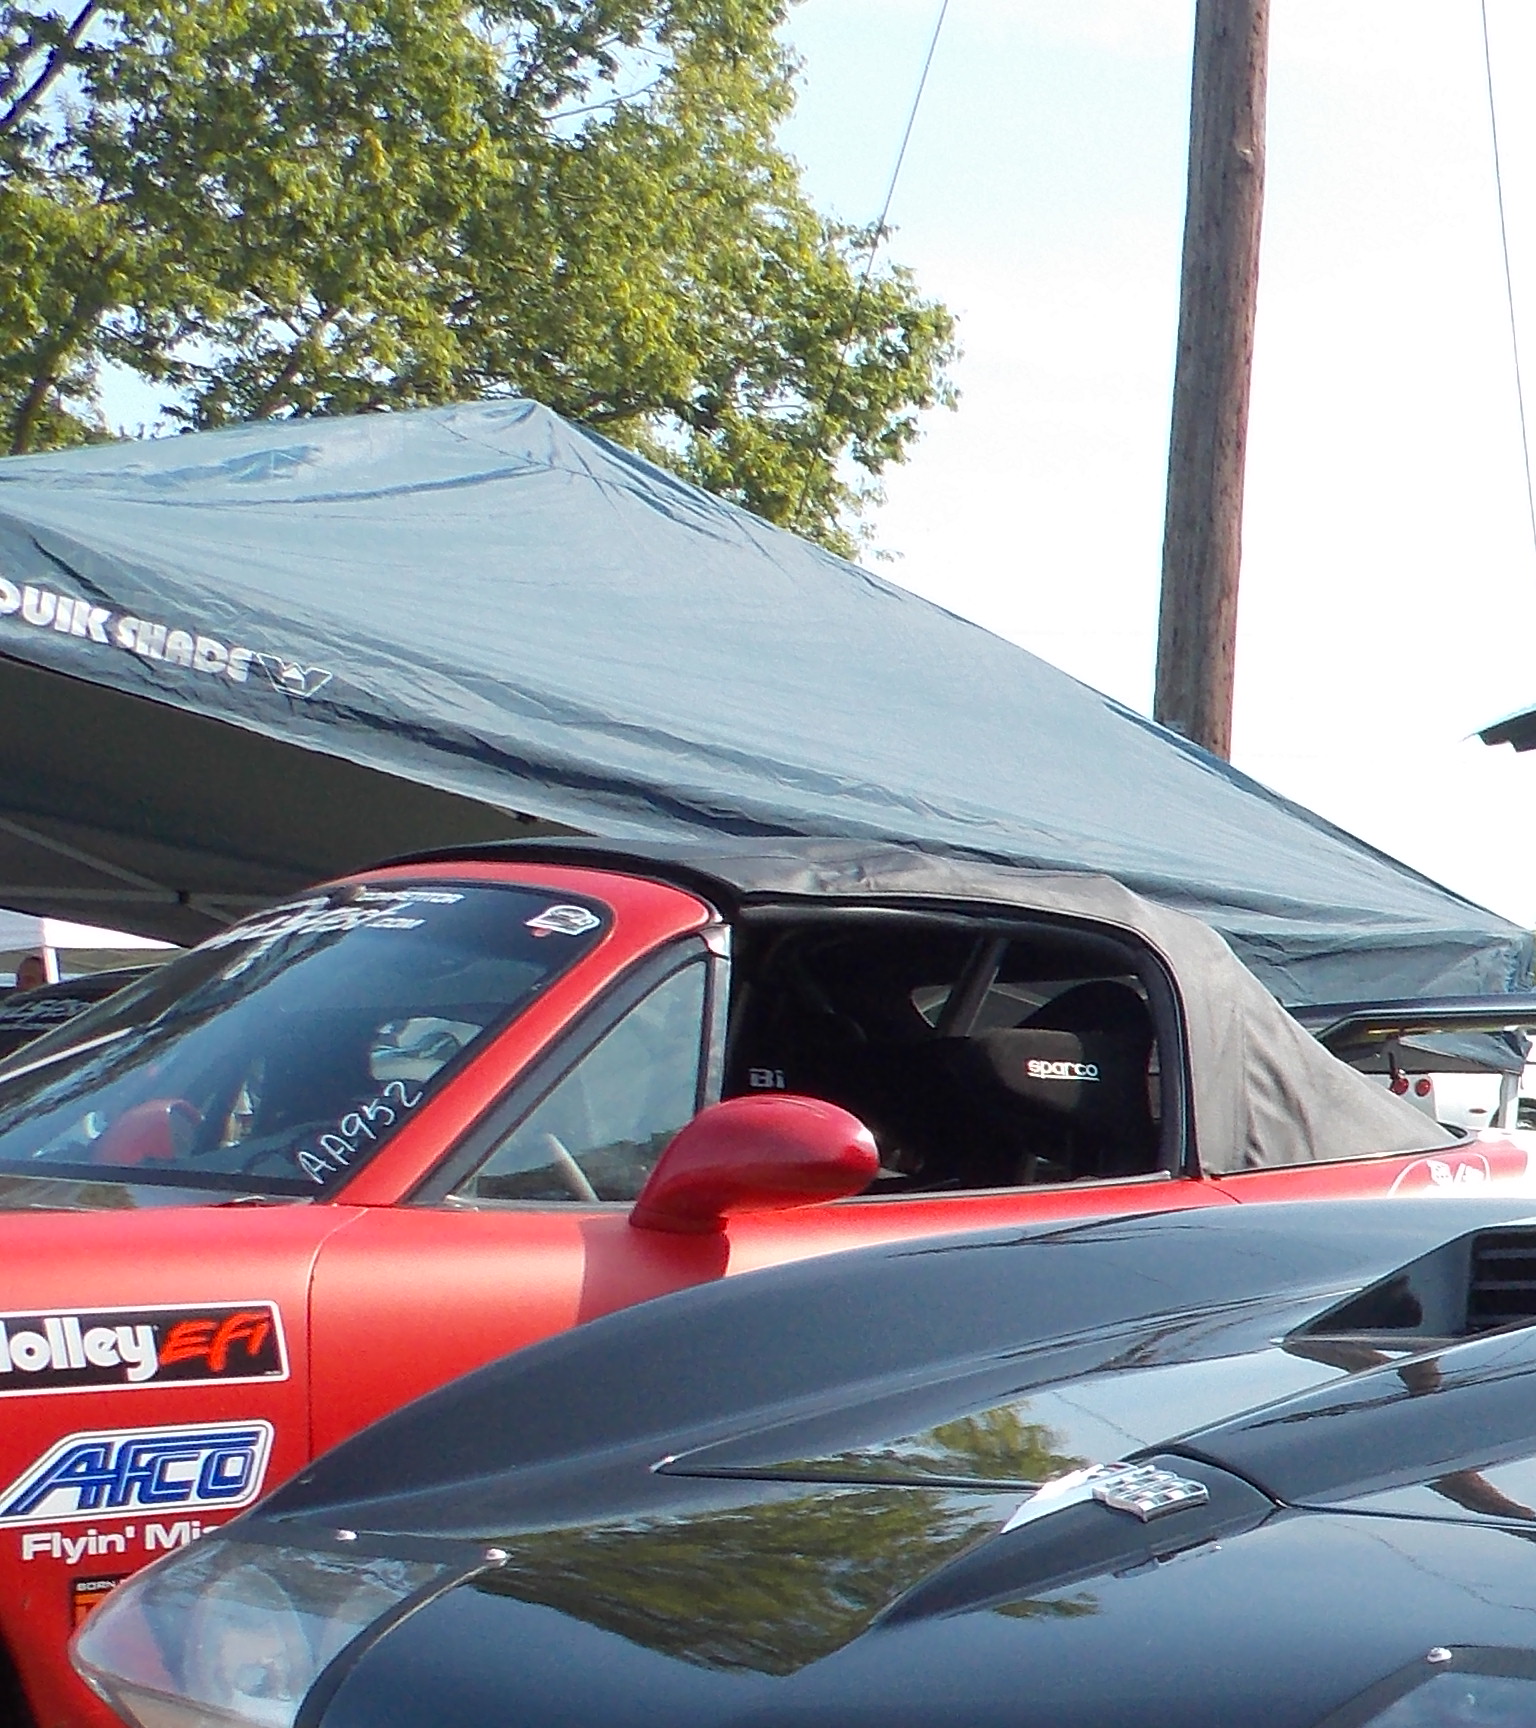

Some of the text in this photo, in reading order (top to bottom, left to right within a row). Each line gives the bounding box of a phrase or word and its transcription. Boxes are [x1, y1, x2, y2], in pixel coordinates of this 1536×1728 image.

[117, 616, 256, 683] SHADE
[1027, 1060, 1098, 1079] sparco
[298, 1081, 423, 1184] AA952
[0, 1317, 158, 1382] olley
[0, 1430, 262, 1517] AFCO
[22, 1525, 135, 1564] Flyin'
